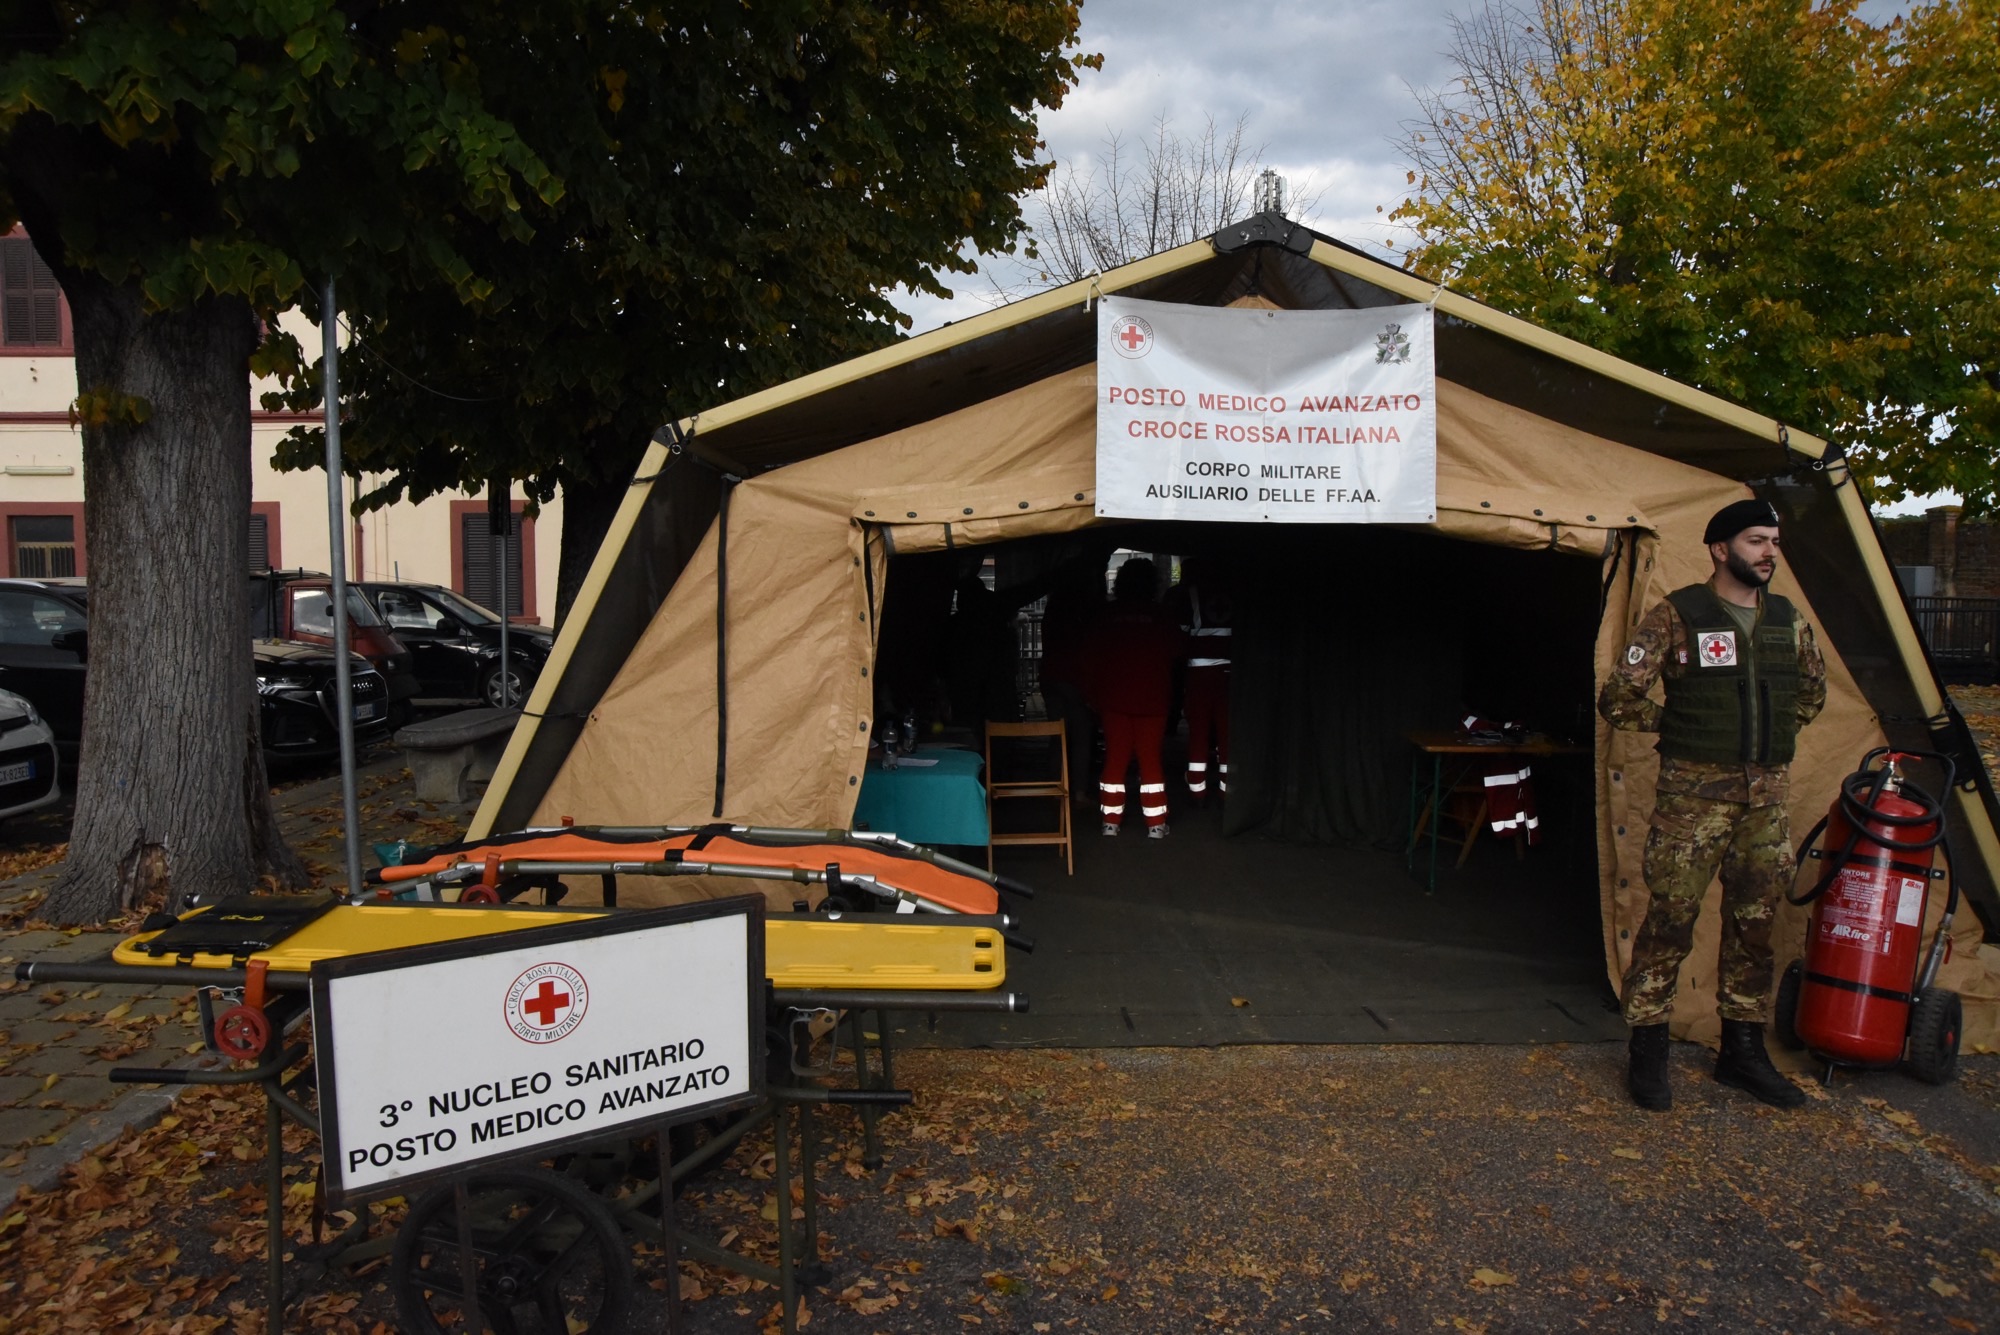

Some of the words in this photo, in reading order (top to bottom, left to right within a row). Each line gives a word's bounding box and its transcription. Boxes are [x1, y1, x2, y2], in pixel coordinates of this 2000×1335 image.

[1109, 386, 1186, 406] POSTO
[1198, 393, 1287, 413] MEDICO
[1299, 394, 1421, 412] AVANZATO
[1127, 420, 1208, 440] CROCE
[1215, 424, 1292, 443] ROSSA
[1297, 426, 1401, 444] ITALIANA
[1186, 461, 1251, 478] CORPO
[1261, 464, 1341, 479] MILITARE
[1146, 484, 1249, 501] AUSILIARIO
[1258, 487, 1316, 503] DELLE
[1326, 489, 1381, 503] FF.AA.
[508, 980, 527, 1009] CROCE
[525, 966, 553, 982] ROSSA
[555, 966, 585, 997] ITALIANA
[514, 1022, 541, 1041] CORPO
[545, 1011, 581, 1040] MILITARE
[380, 1101, 413, 1128] 3°
[429, 1072, 552, 1118] NUCLEO
[565, 1038, 705, 1087] SANITARIO
[348, 1128, 457, 1174] POSTO
[470, 1098, 586, 1144] MEDICO
[598, 1065, 730, 1114] AVANZATO
